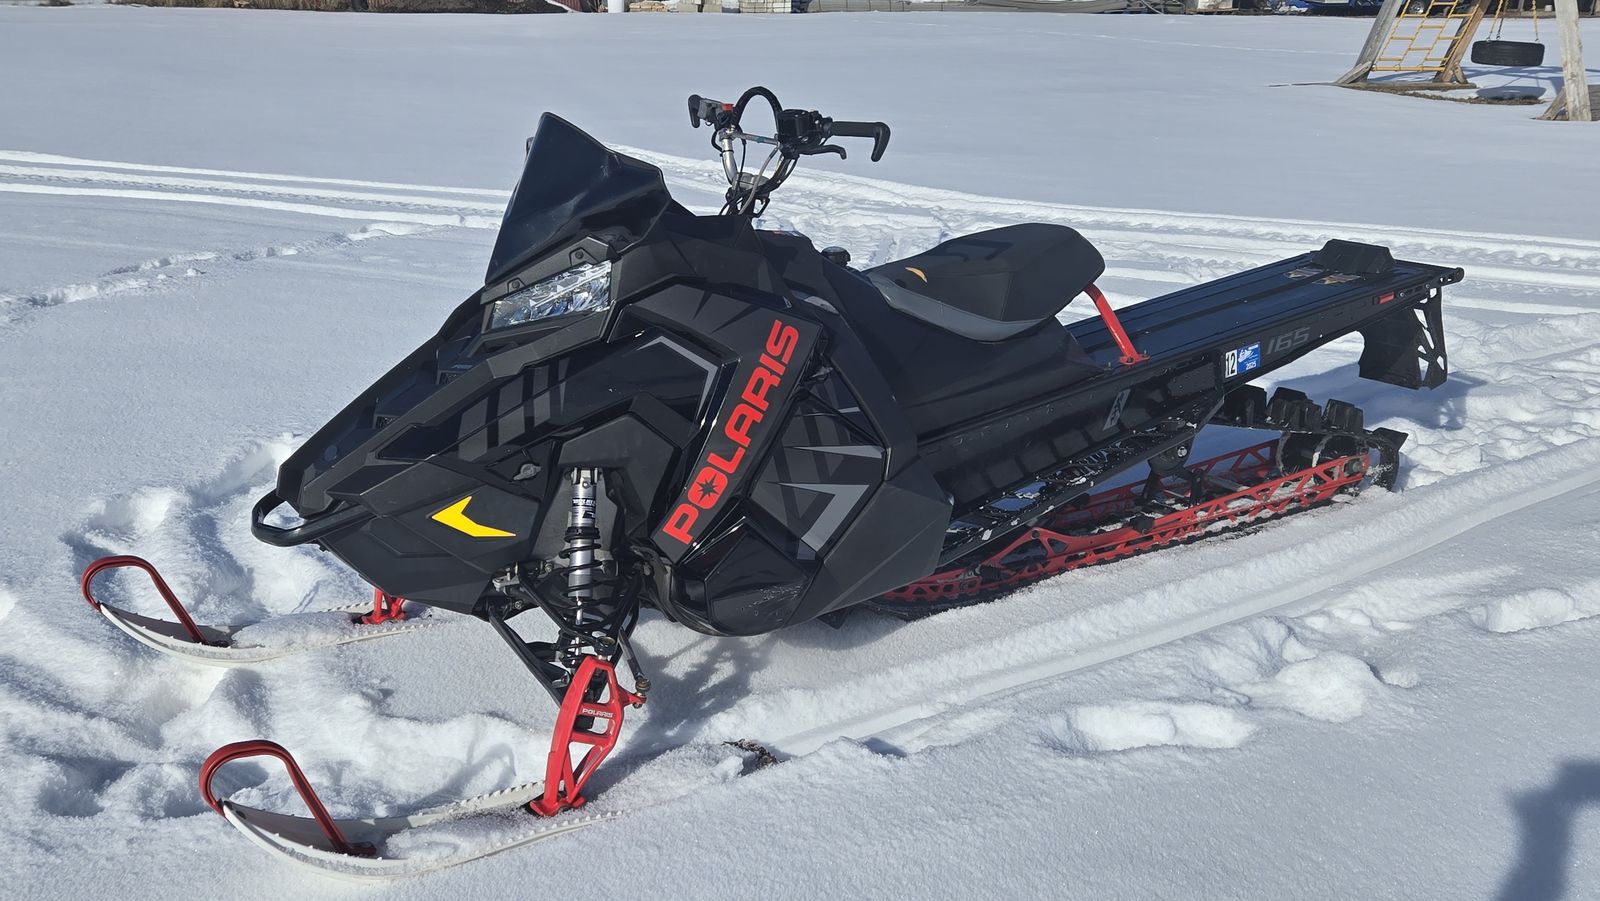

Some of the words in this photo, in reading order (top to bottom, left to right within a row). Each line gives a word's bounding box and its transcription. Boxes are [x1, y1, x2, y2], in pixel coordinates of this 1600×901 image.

[1266, 326, 1311, 355] 165
[1226, 352, 1236, 376] 12
[662, 319, 799, 545] POLARIS
[582, 708, 614, 718] POLARIS
